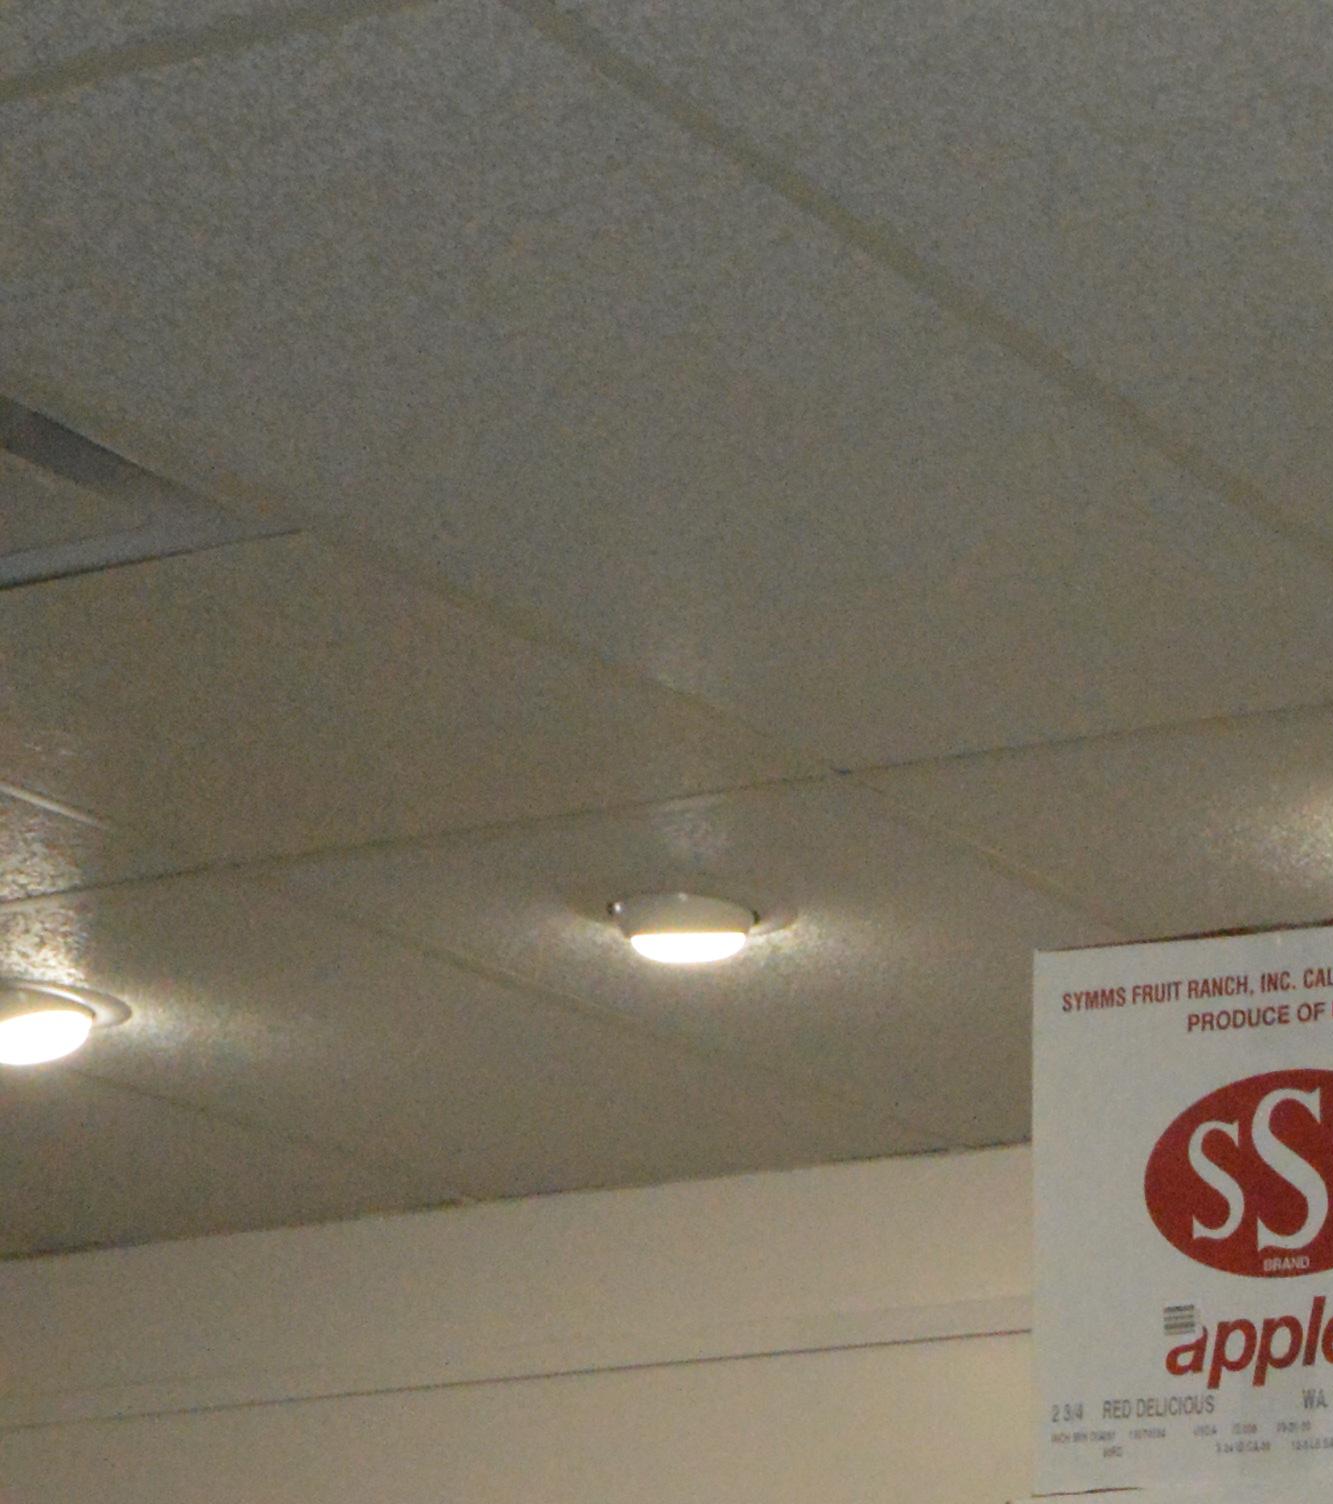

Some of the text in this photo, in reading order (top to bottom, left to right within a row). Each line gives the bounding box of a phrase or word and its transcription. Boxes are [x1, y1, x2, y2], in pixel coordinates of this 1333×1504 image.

[1062, 987, 1127, 1012] SYMMS
[1131, 980, 1182, 1004] FRUIT
[1187, 975, 1255, 999] RANCH,
[1259, 970, 1297, 994] INC.
[1186, 1003, 1291, 1033] PRODUCE
[1295, 1001, 1326, 1024] OF
[1263, 1256, 1310, 1273] BRAND
